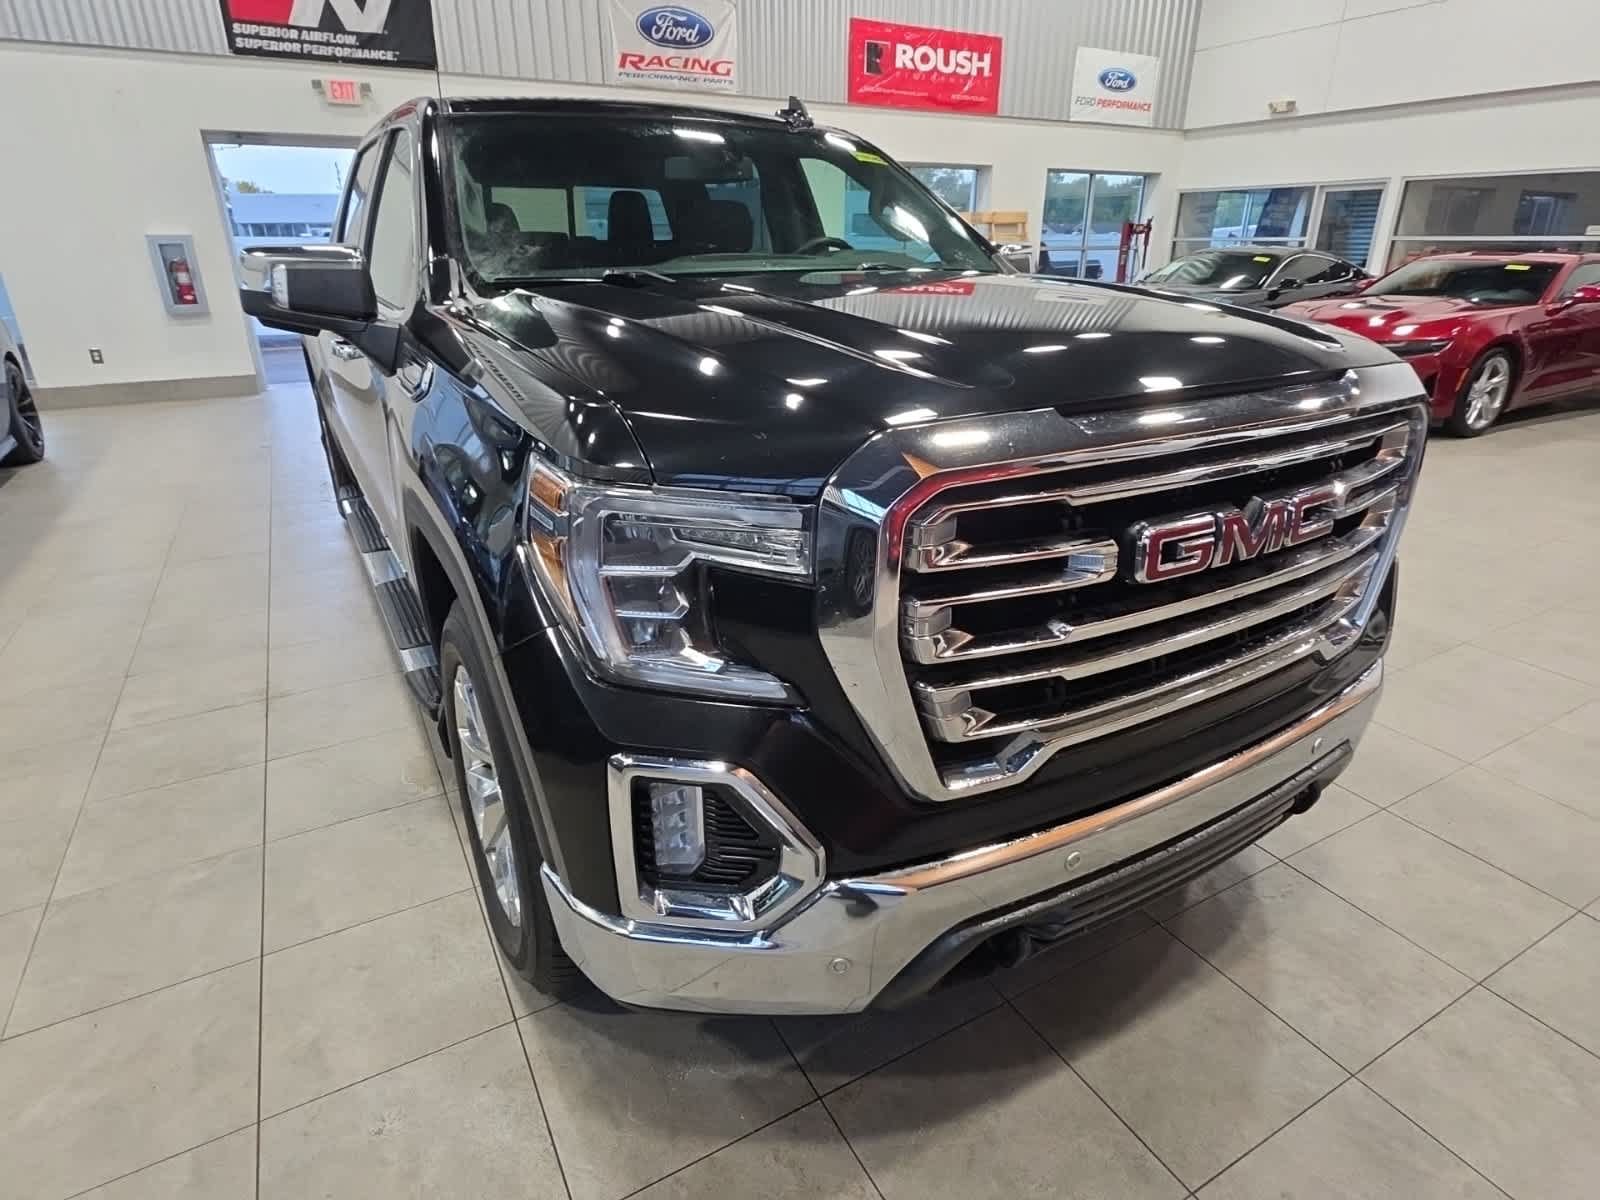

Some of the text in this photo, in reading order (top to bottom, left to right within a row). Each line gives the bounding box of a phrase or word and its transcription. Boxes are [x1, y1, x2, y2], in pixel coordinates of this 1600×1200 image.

[232, 22, 359, 46] SUPERIOR AIRFLOW.
[651, 12, 700, 43] Ford
[235, 38, 301, 53] SUPERIOR
[618, 53, 734, 76] RACING
[895, 43, 992, 77] ROUSH
[618, 71, 698, 83] PERFORMANCE
[1104, 71, 1130, 88] Ford
[1075, 96, 1152, 112] FORD PERFORMANCE
[1135, 484, 1341, 584] GMC
